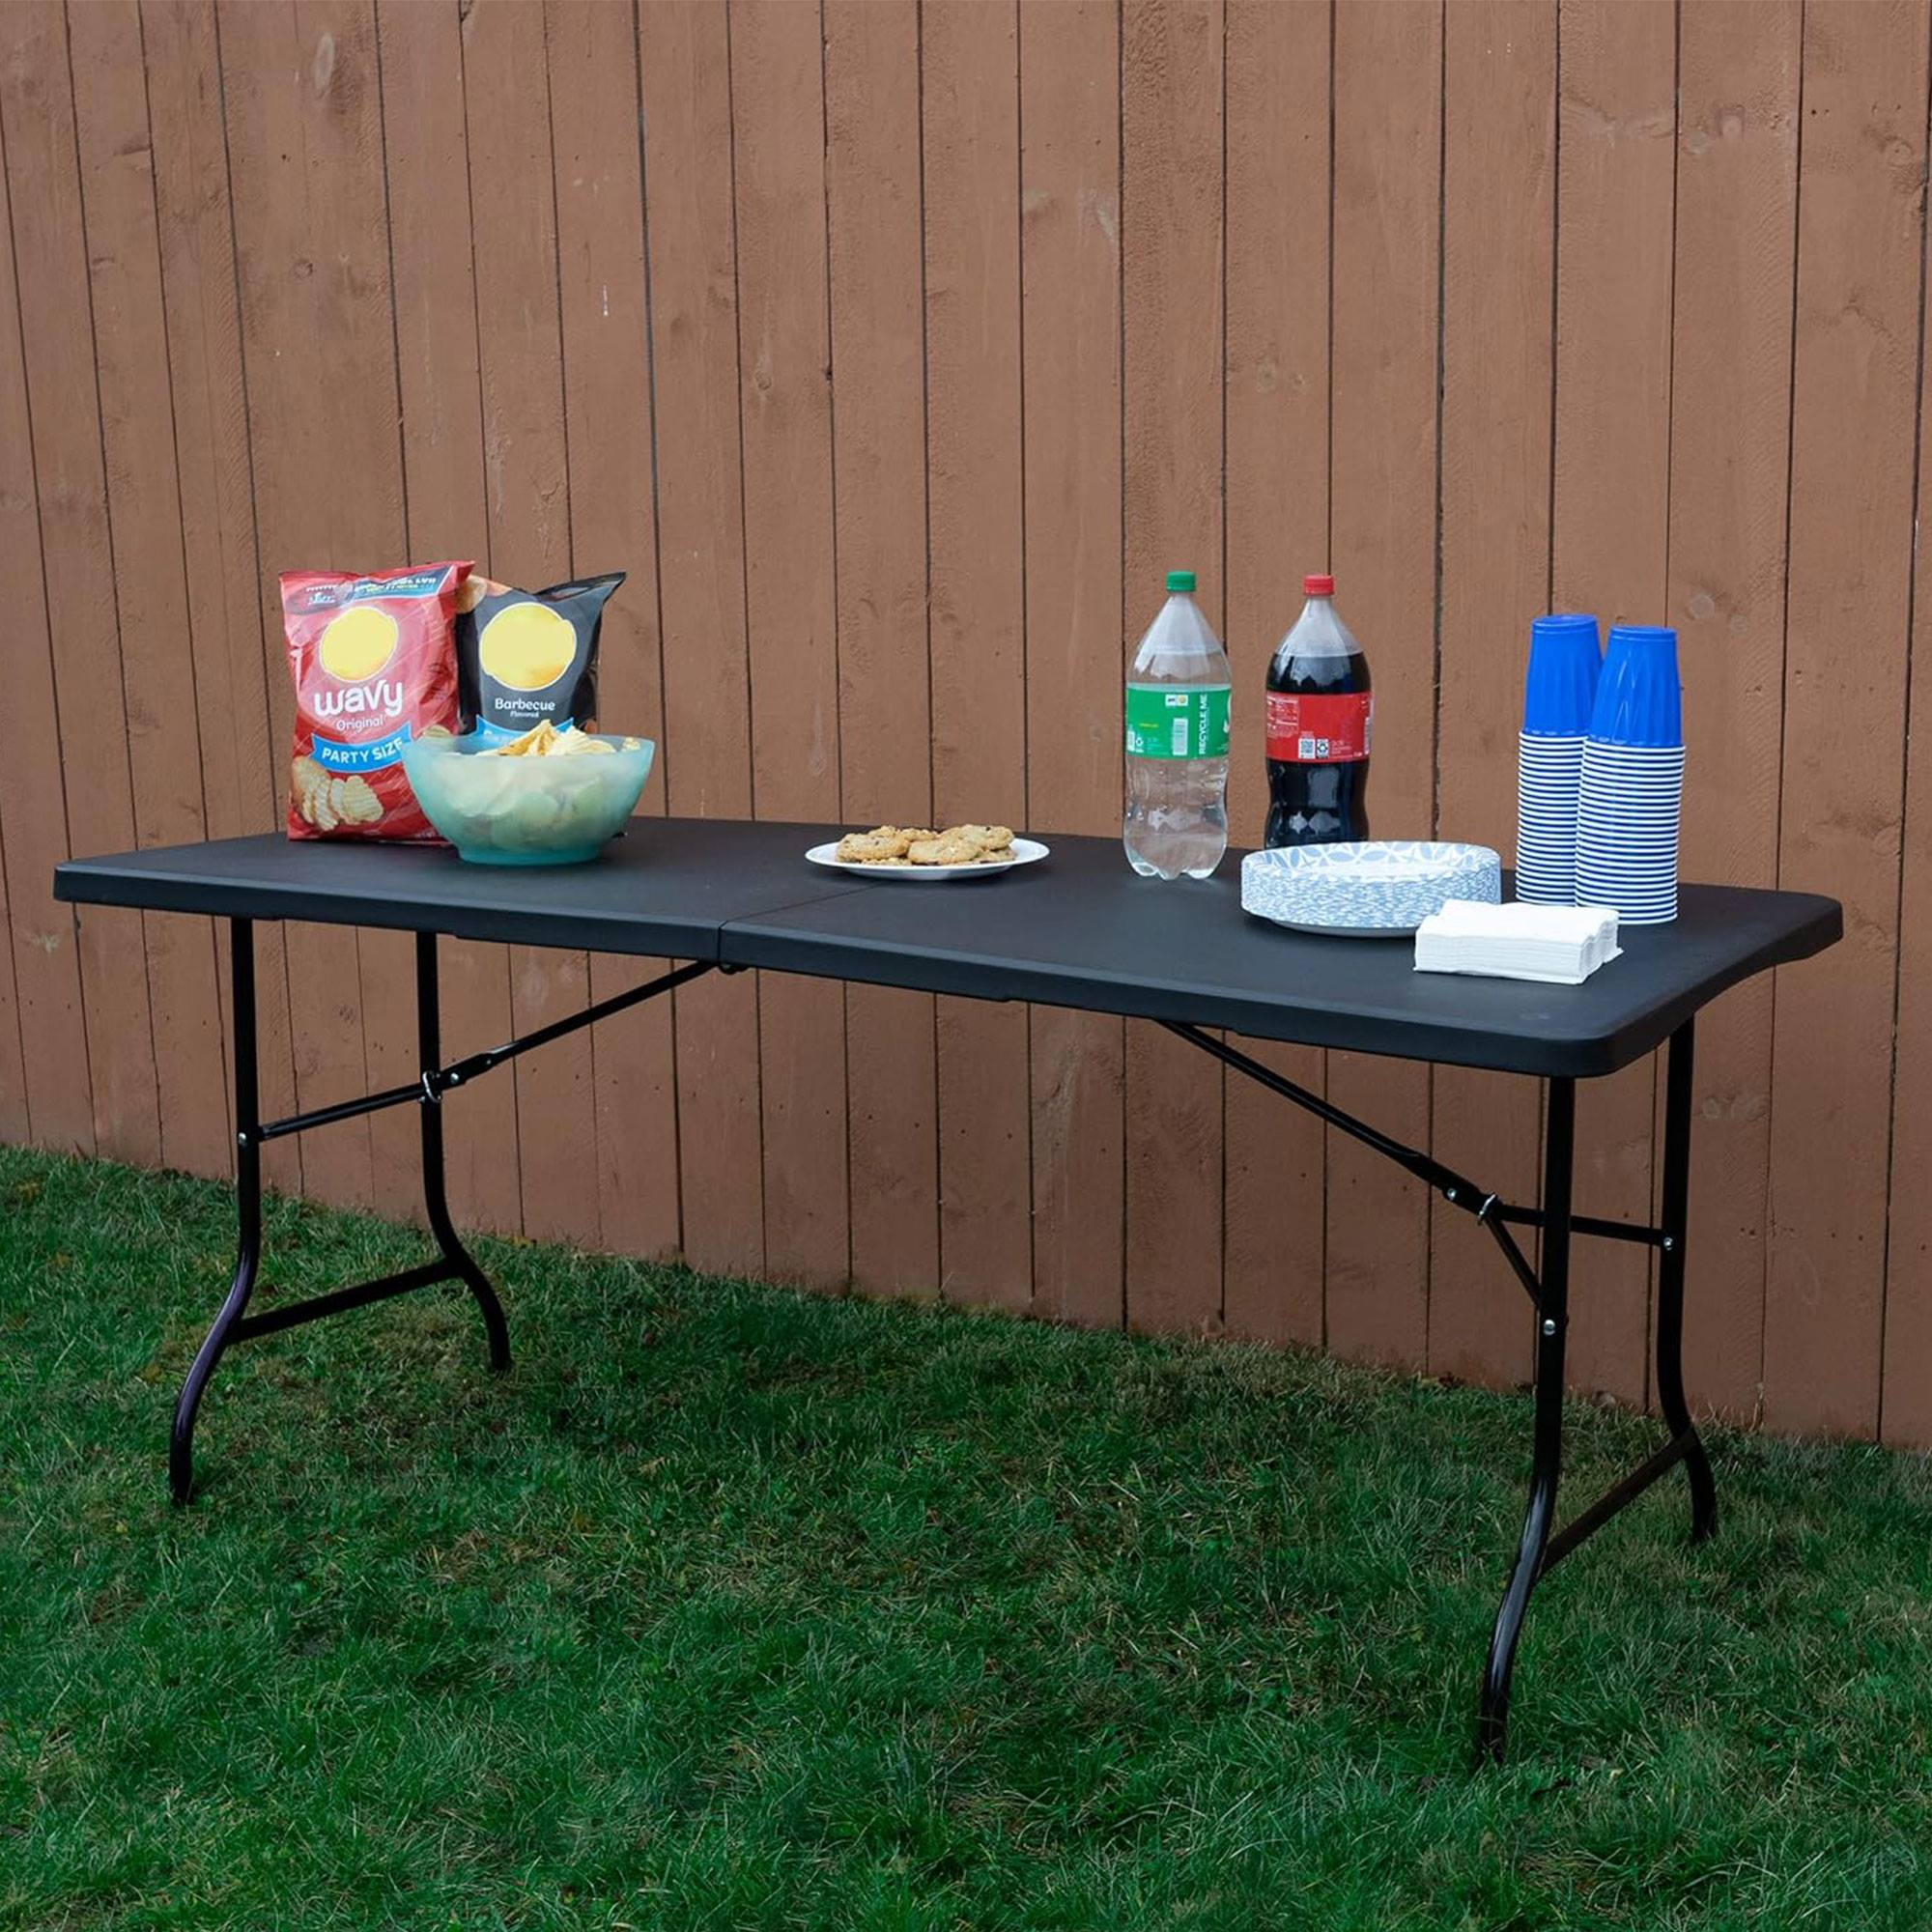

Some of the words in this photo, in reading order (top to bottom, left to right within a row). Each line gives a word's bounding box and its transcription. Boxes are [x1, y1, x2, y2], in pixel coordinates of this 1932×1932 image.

[314, 679, 403, 717] wavy
[495, 697, 555, 711] Barbecue
[1199, 693, 1207, 709] ME
[336, 714, 384, 732] Original
[322, 747, 369, 764] PARTY
